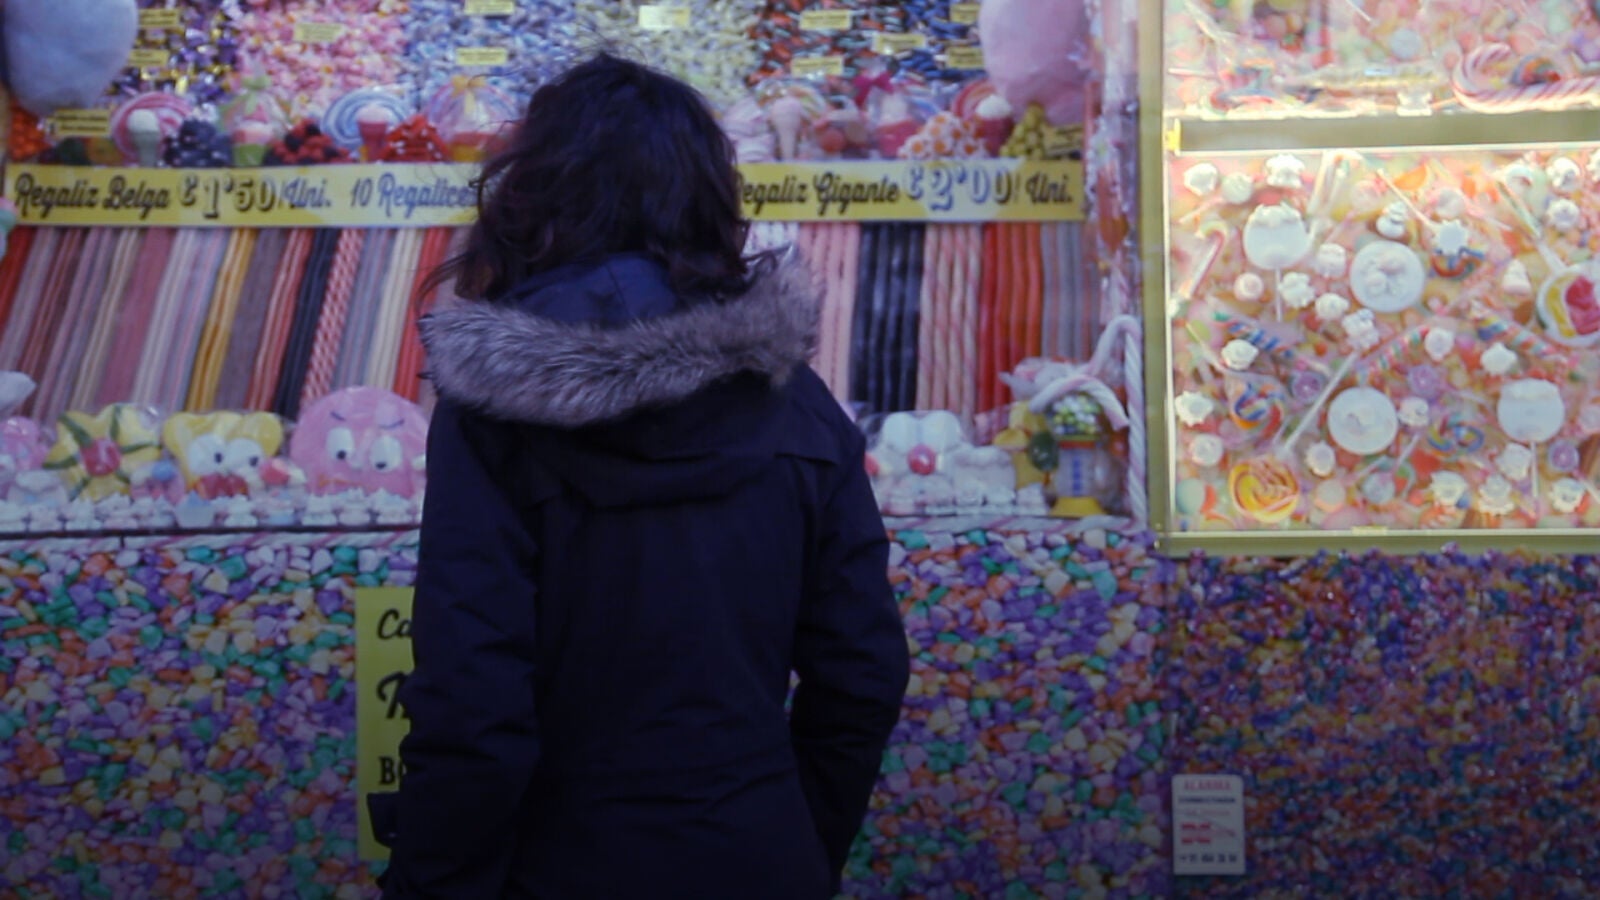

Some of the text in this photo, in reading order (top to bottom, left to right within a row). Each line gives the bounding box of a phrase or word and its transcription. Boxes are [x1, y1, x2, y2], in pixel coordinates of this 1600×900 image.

[15, 172, 98, 219] Regaliz
[102, 175, 170, 220] Belga
[351, 177, 373, 207] 10
[813, 171, 899, 217] Gigante
